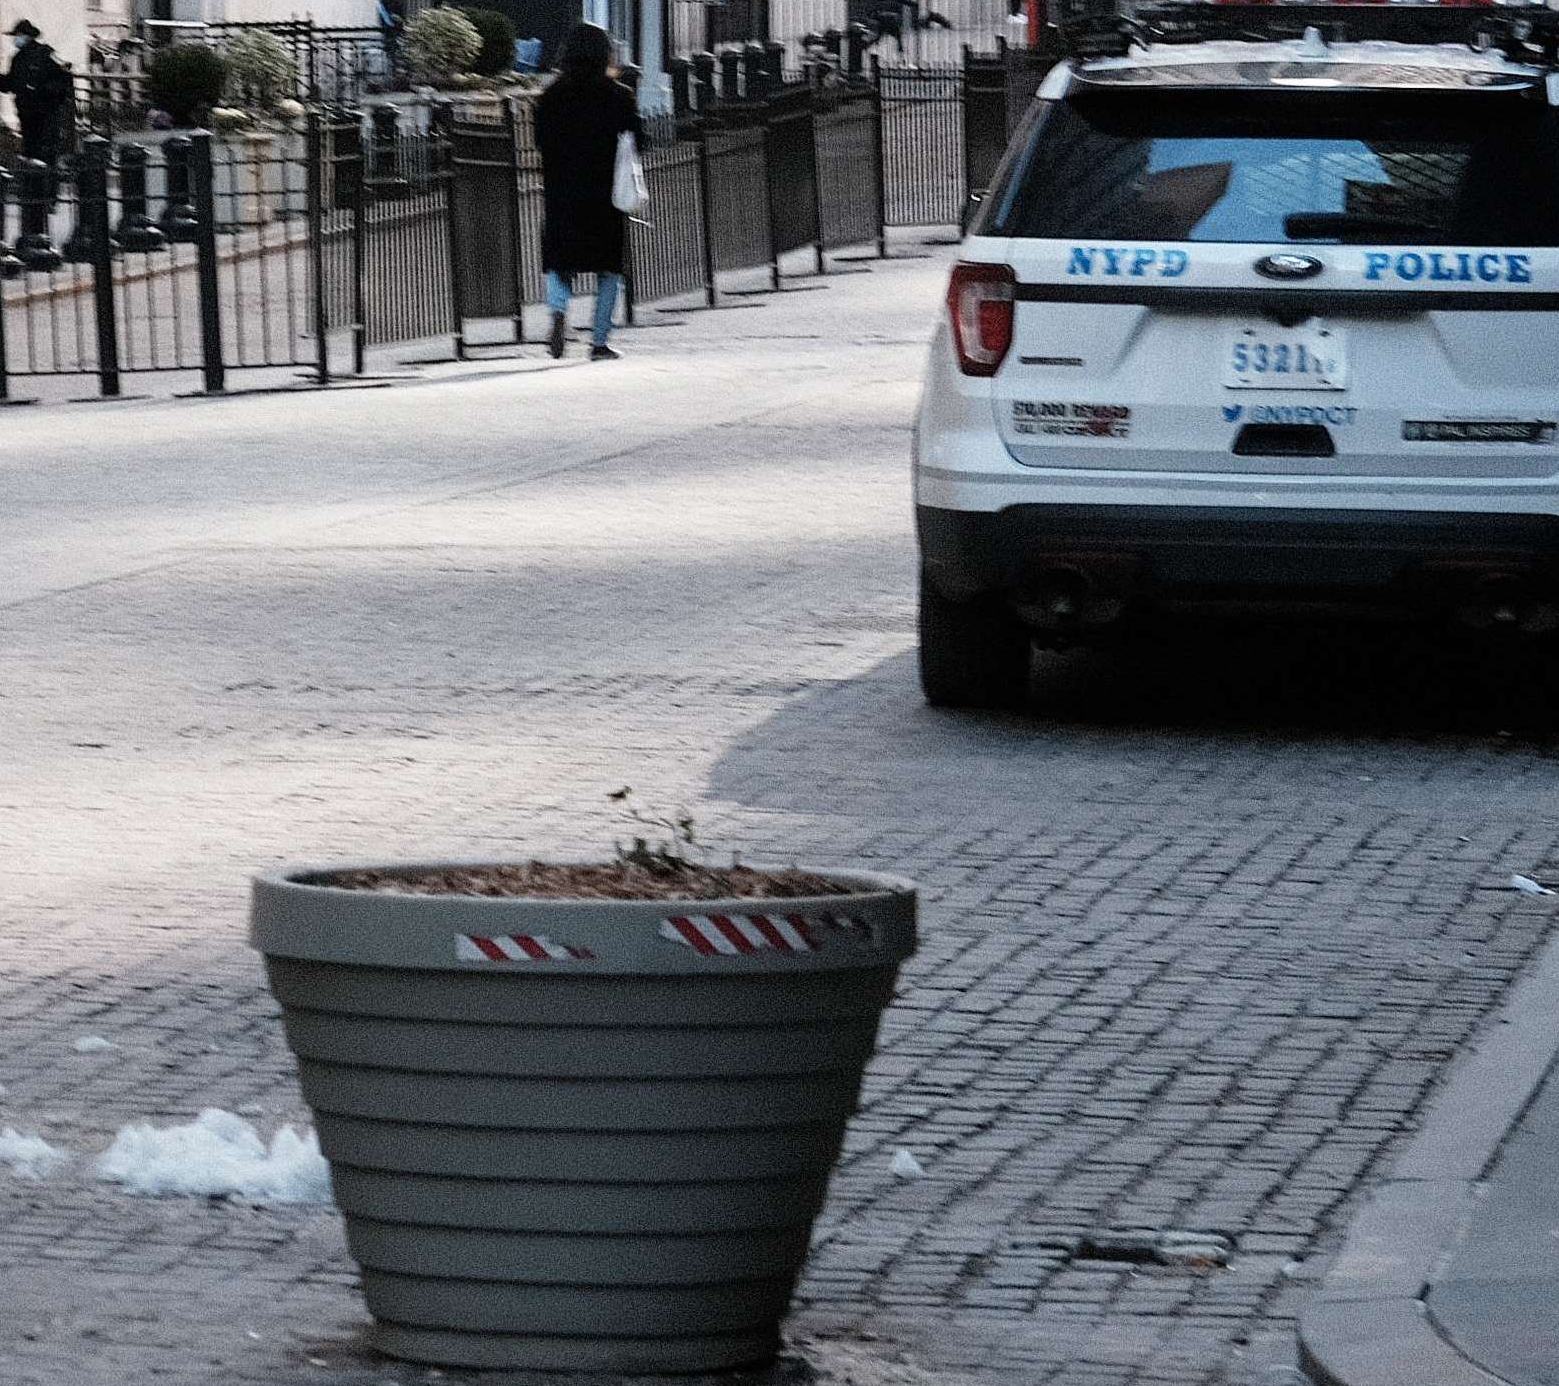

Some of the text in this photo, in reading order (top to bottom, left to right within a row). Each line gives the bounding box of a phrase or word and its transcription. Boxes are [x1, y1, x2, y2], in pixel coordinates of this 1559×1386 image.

[1066, 247, 1532, 283] NYPD POLICE
[1233, 342, 1308, 374] 5321
